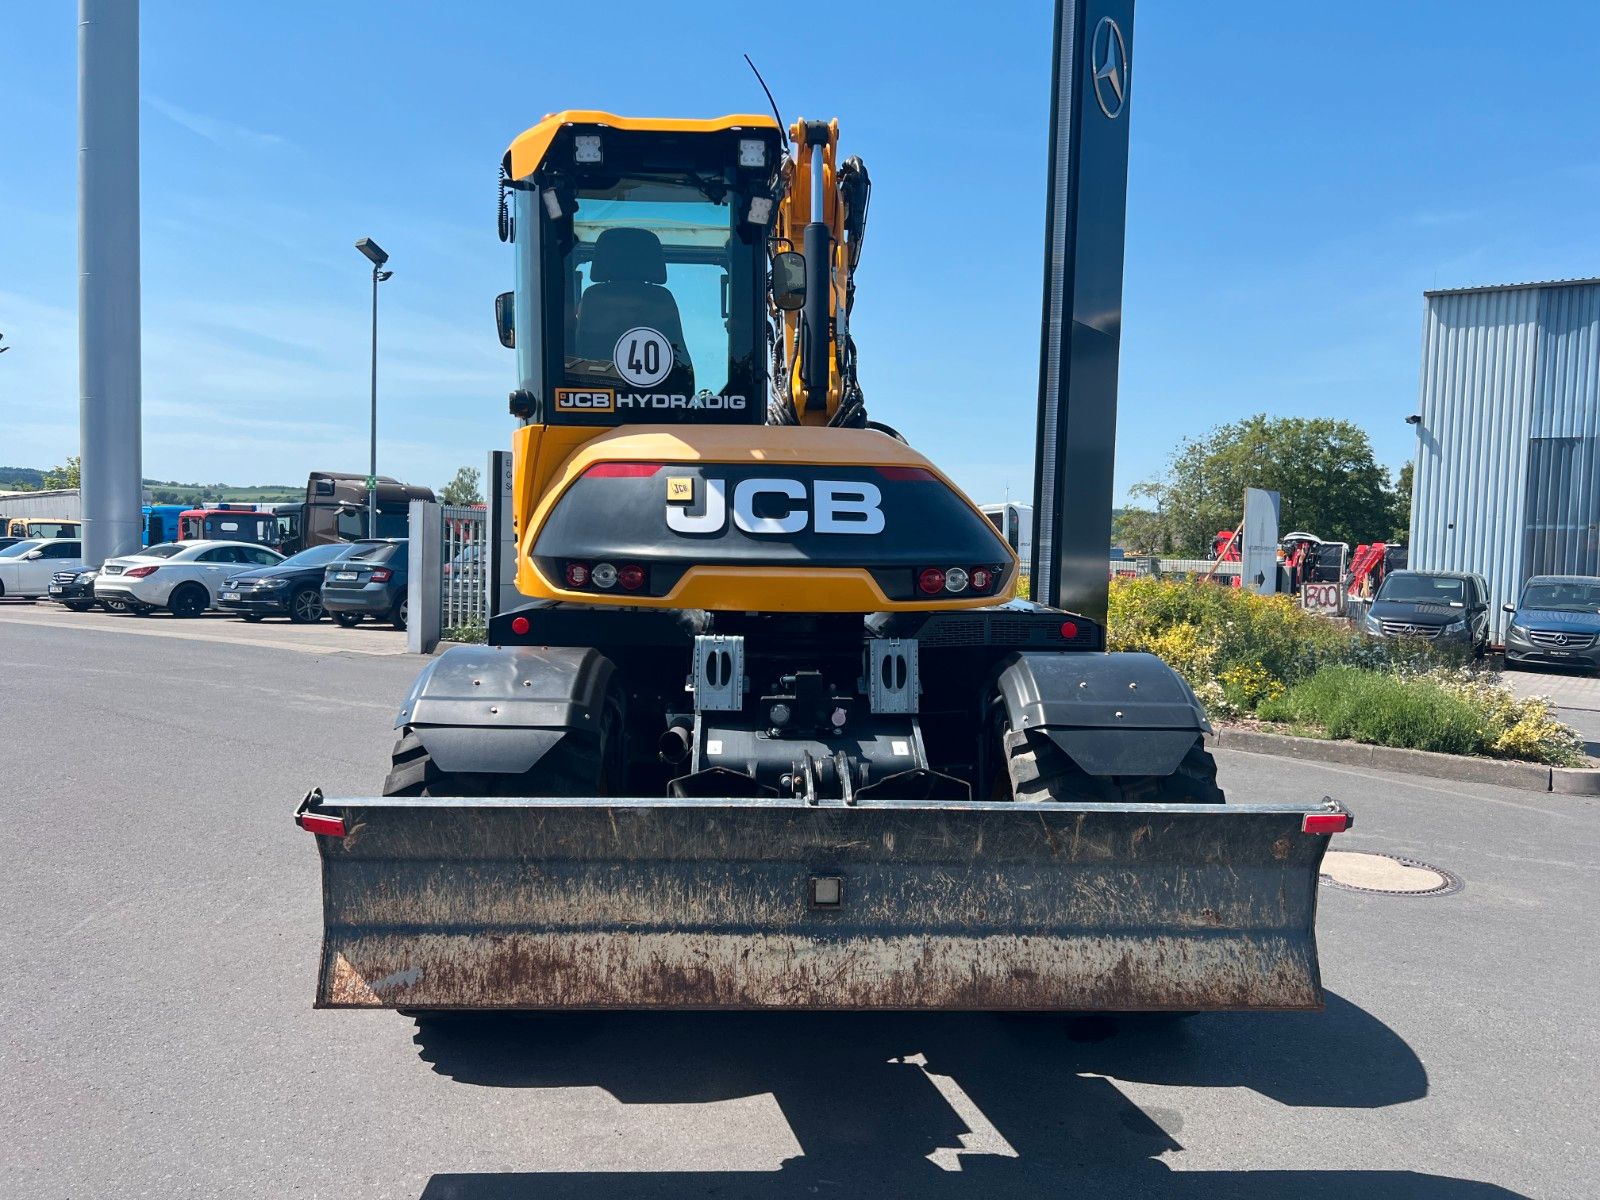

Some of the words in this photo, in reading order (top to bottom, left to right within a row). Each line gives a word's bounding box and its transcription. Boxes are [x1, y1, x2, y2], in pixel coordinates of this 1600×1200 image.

[627, 339, 660, 375] 40
[559, 392, 610, 408] JCB
[616, 393, 746, 410] HYDRADIG
[673, 483, 688, 494] JCB
[666, 478, 886, 535] JCB
